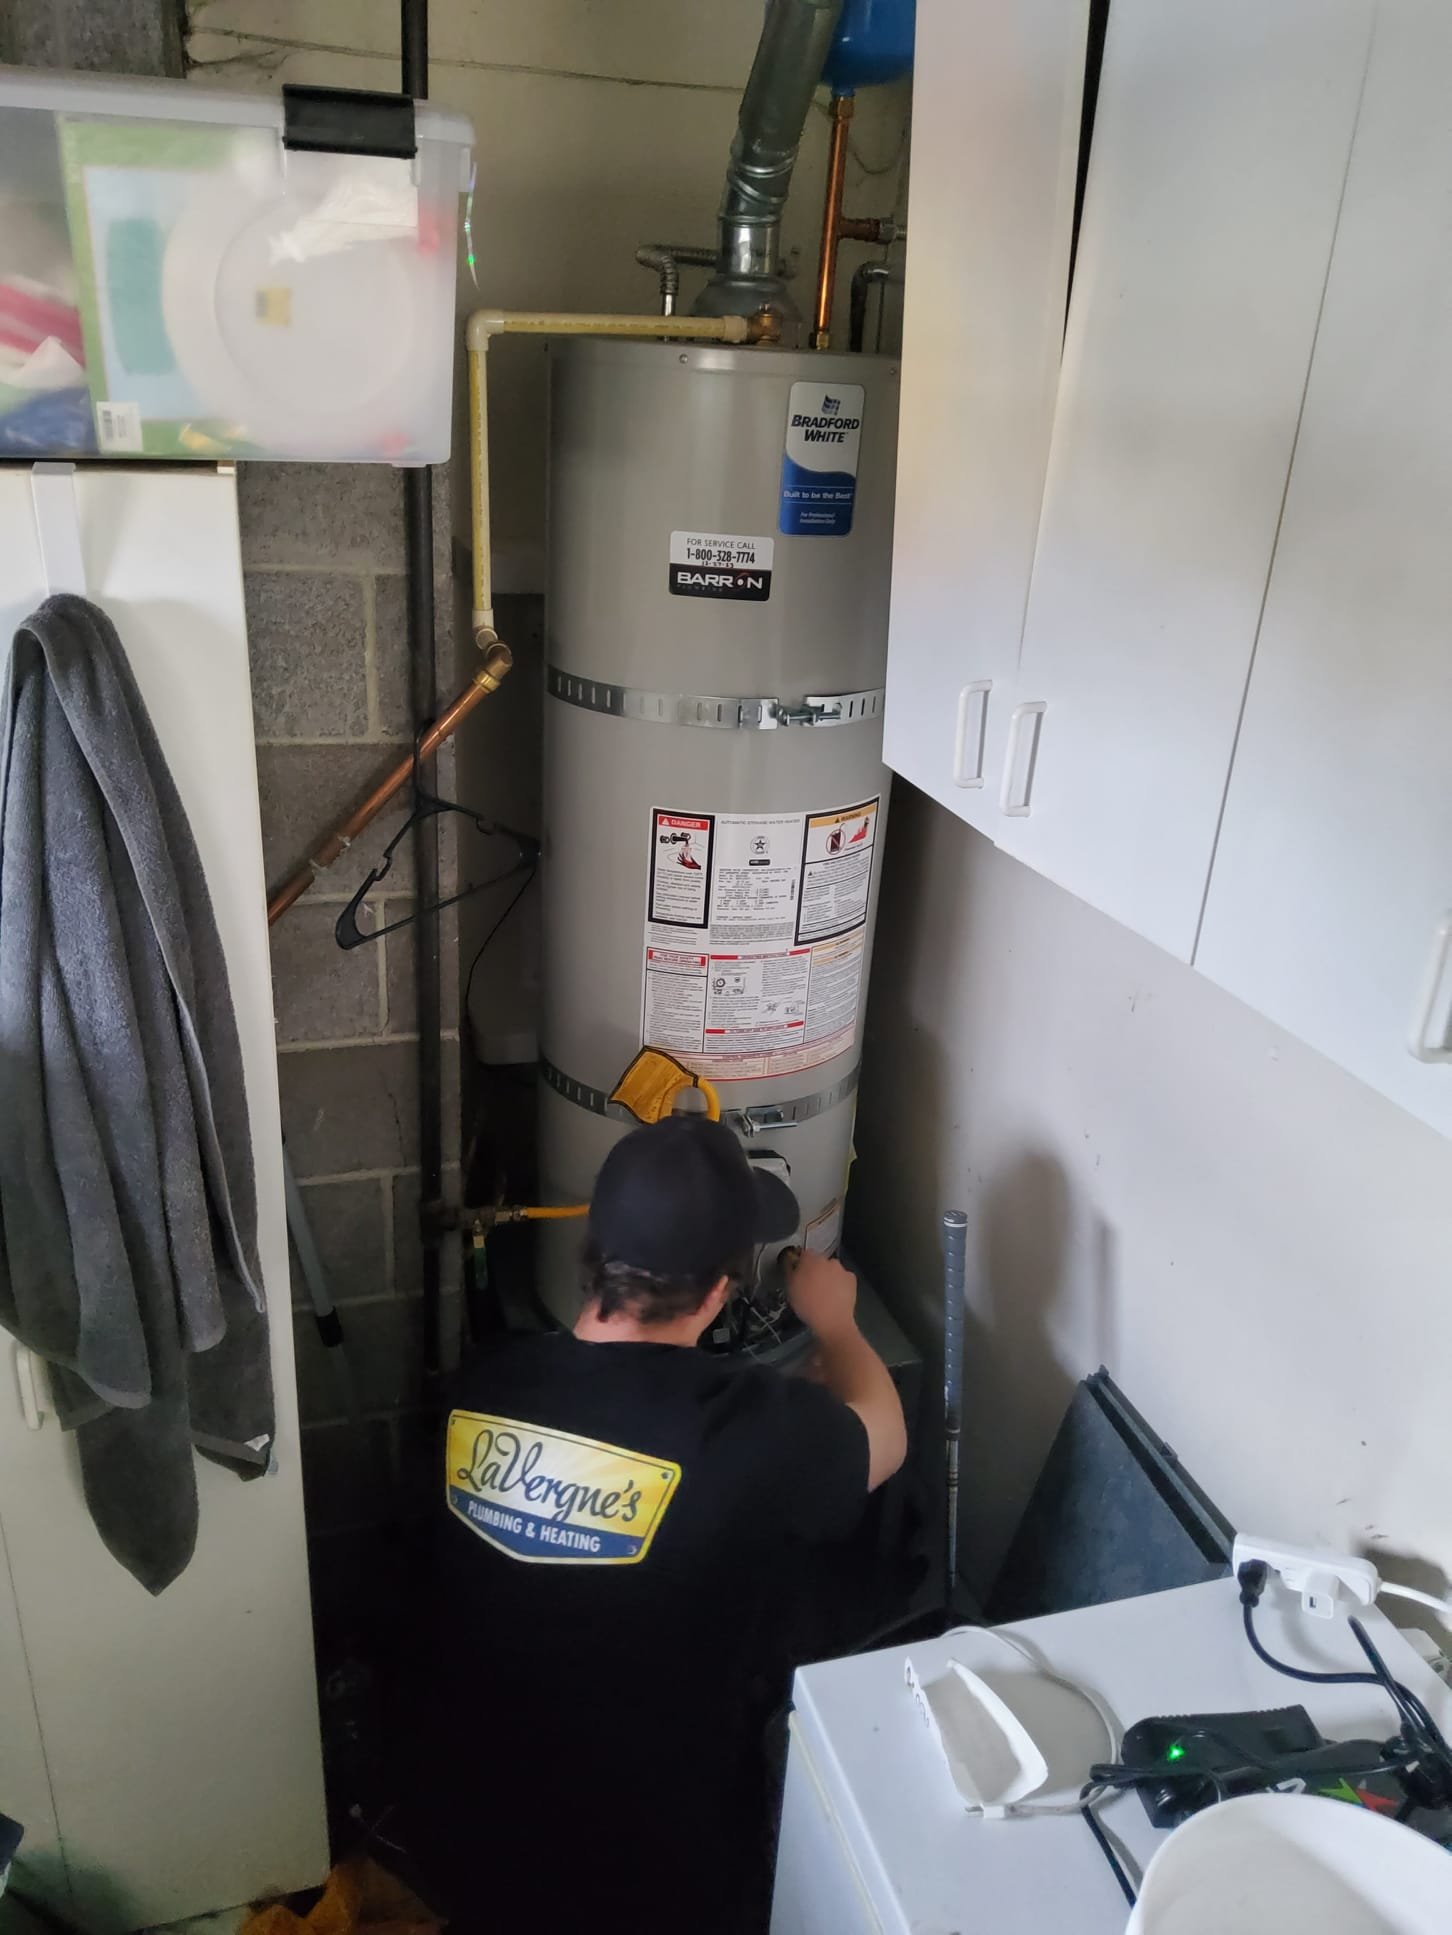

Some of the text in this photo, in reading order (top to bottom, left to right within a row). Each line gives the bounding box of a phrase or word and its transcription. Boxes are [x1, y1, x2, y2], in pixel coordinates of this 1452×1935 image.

[791, 414, 860, 430] BRADFORD
[804, 429, 847, 443] WHITE
[686, 538, 757, 550] FOR SERVICE CALL
[686, 547, 756, 564] 1-800-328-7774
[671, 819, 701, 828] DANGER
[456, 1429, 642, 1522] LaVergne's
[467, 1500, 600, 1553] PLUMBING & HEATING
